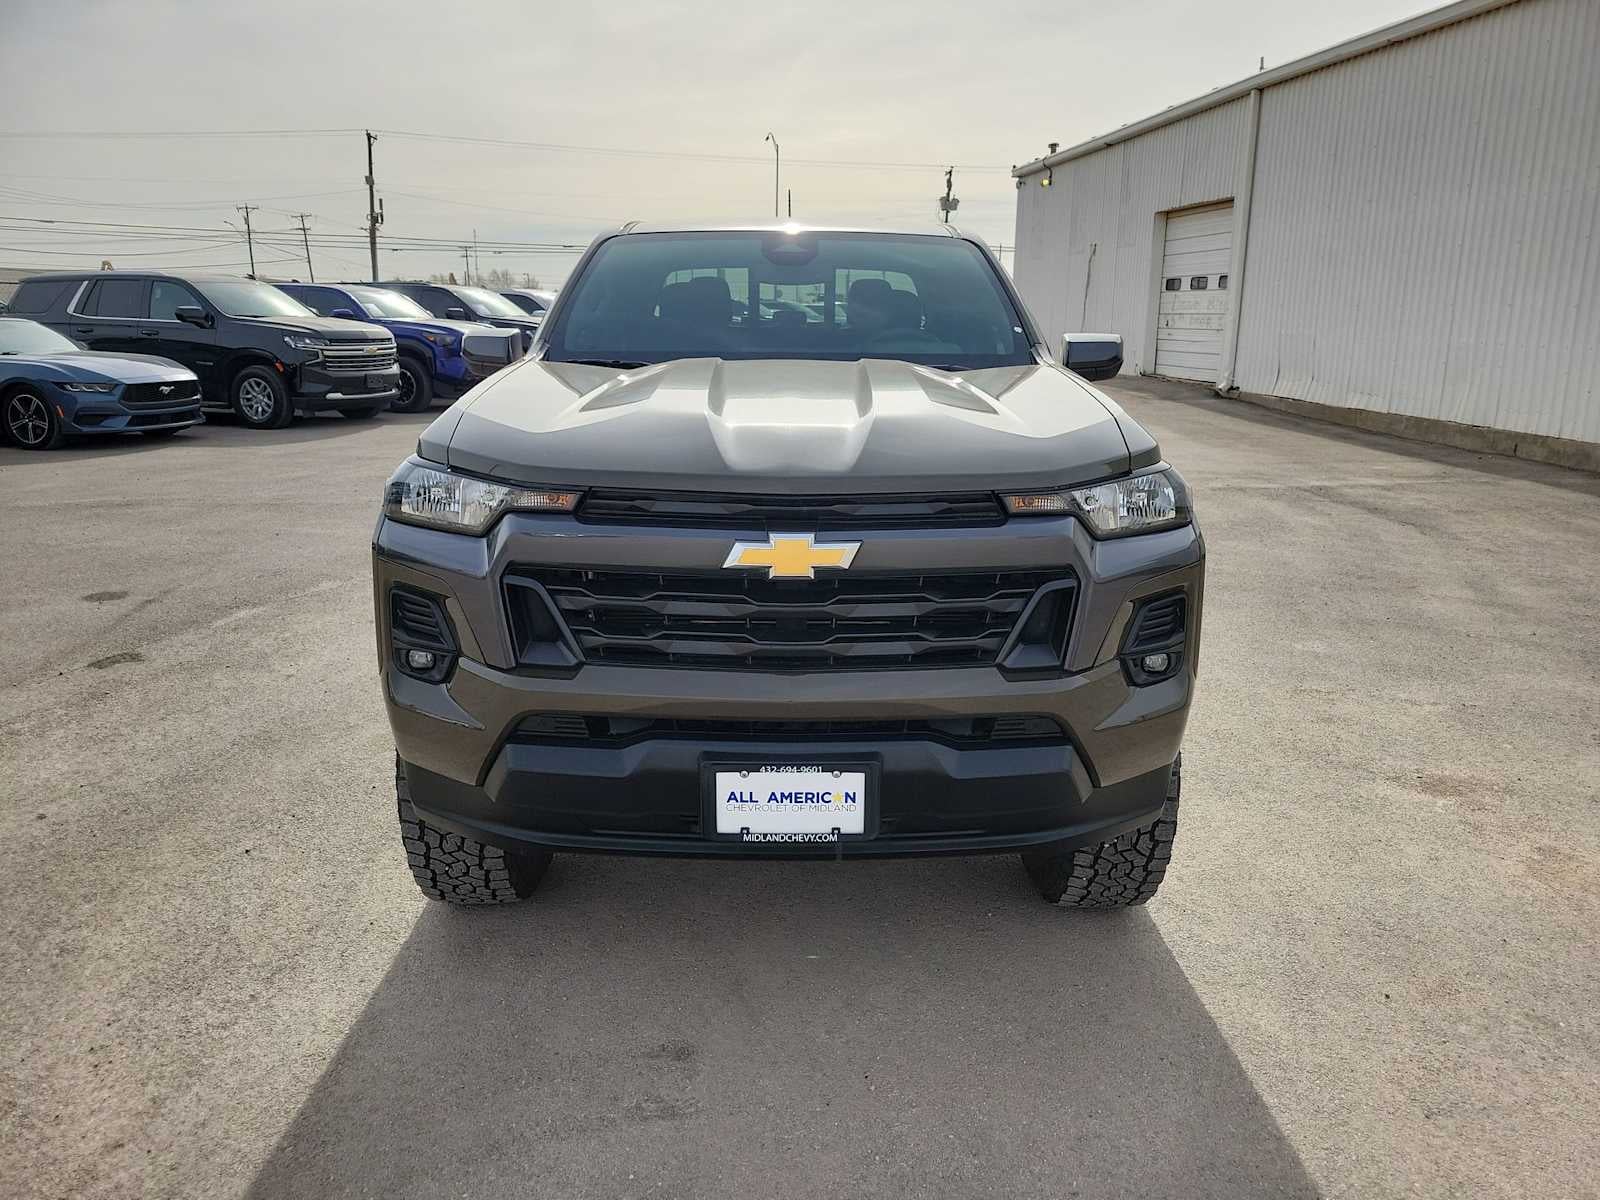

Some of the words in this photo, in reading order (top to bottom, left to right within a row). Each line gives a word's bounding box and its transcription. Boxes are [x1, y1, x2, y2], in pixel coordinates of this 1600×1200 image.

[759, 766, 823, 774] 432-694-9601
[727, 791, 758, 804] ALL
[726, 804, 788, 813] CHEVROLET
[791, 804, 806, 813] OF
[809, 804, 857, 813] MIDLAND
[743, 833, 838, 843] MIDLANDCHEVY.COM
